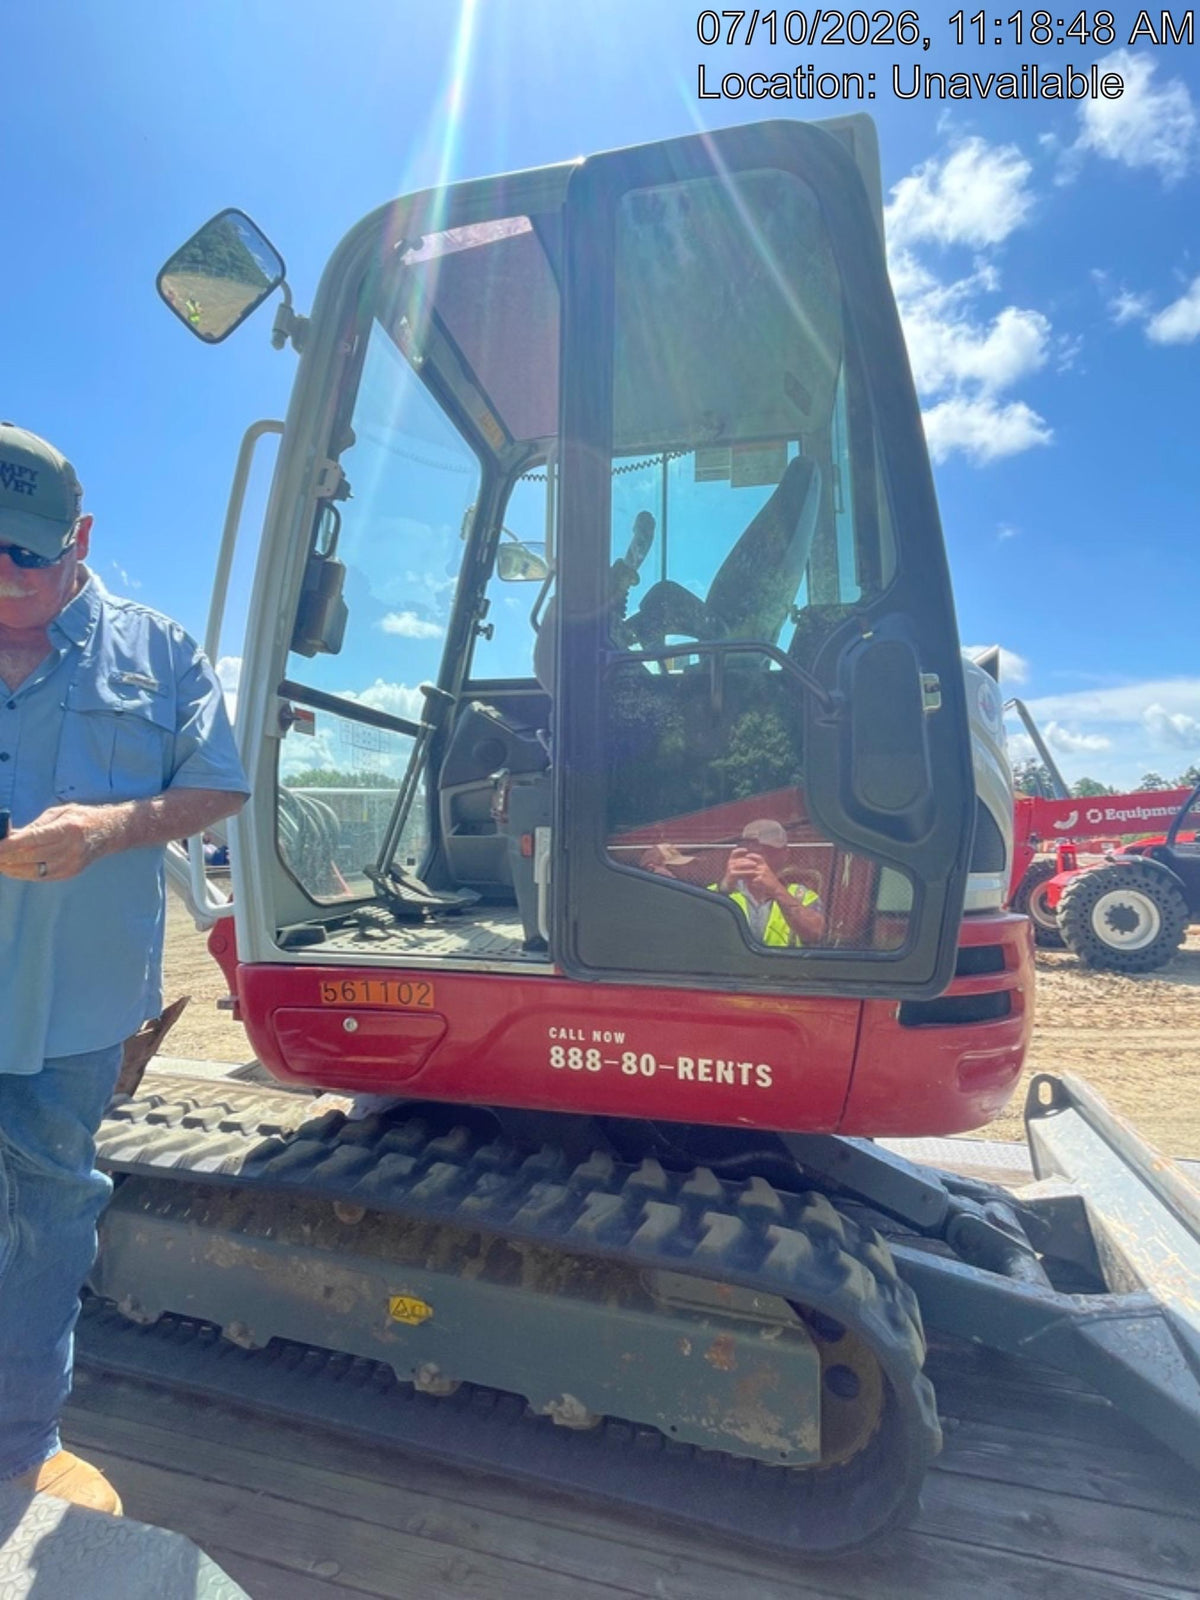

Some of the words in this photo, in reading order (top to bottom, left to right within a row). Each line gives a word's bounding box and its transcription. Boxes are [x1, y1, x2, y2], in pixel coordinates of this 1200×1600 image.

[323, 980, 431, 1006] 561102
[549, 1027, 586, 1041] CALL
[592, 1030, 626, 1044] NOW
[550, 1045, 773, 1088] 888-80-RENTS
